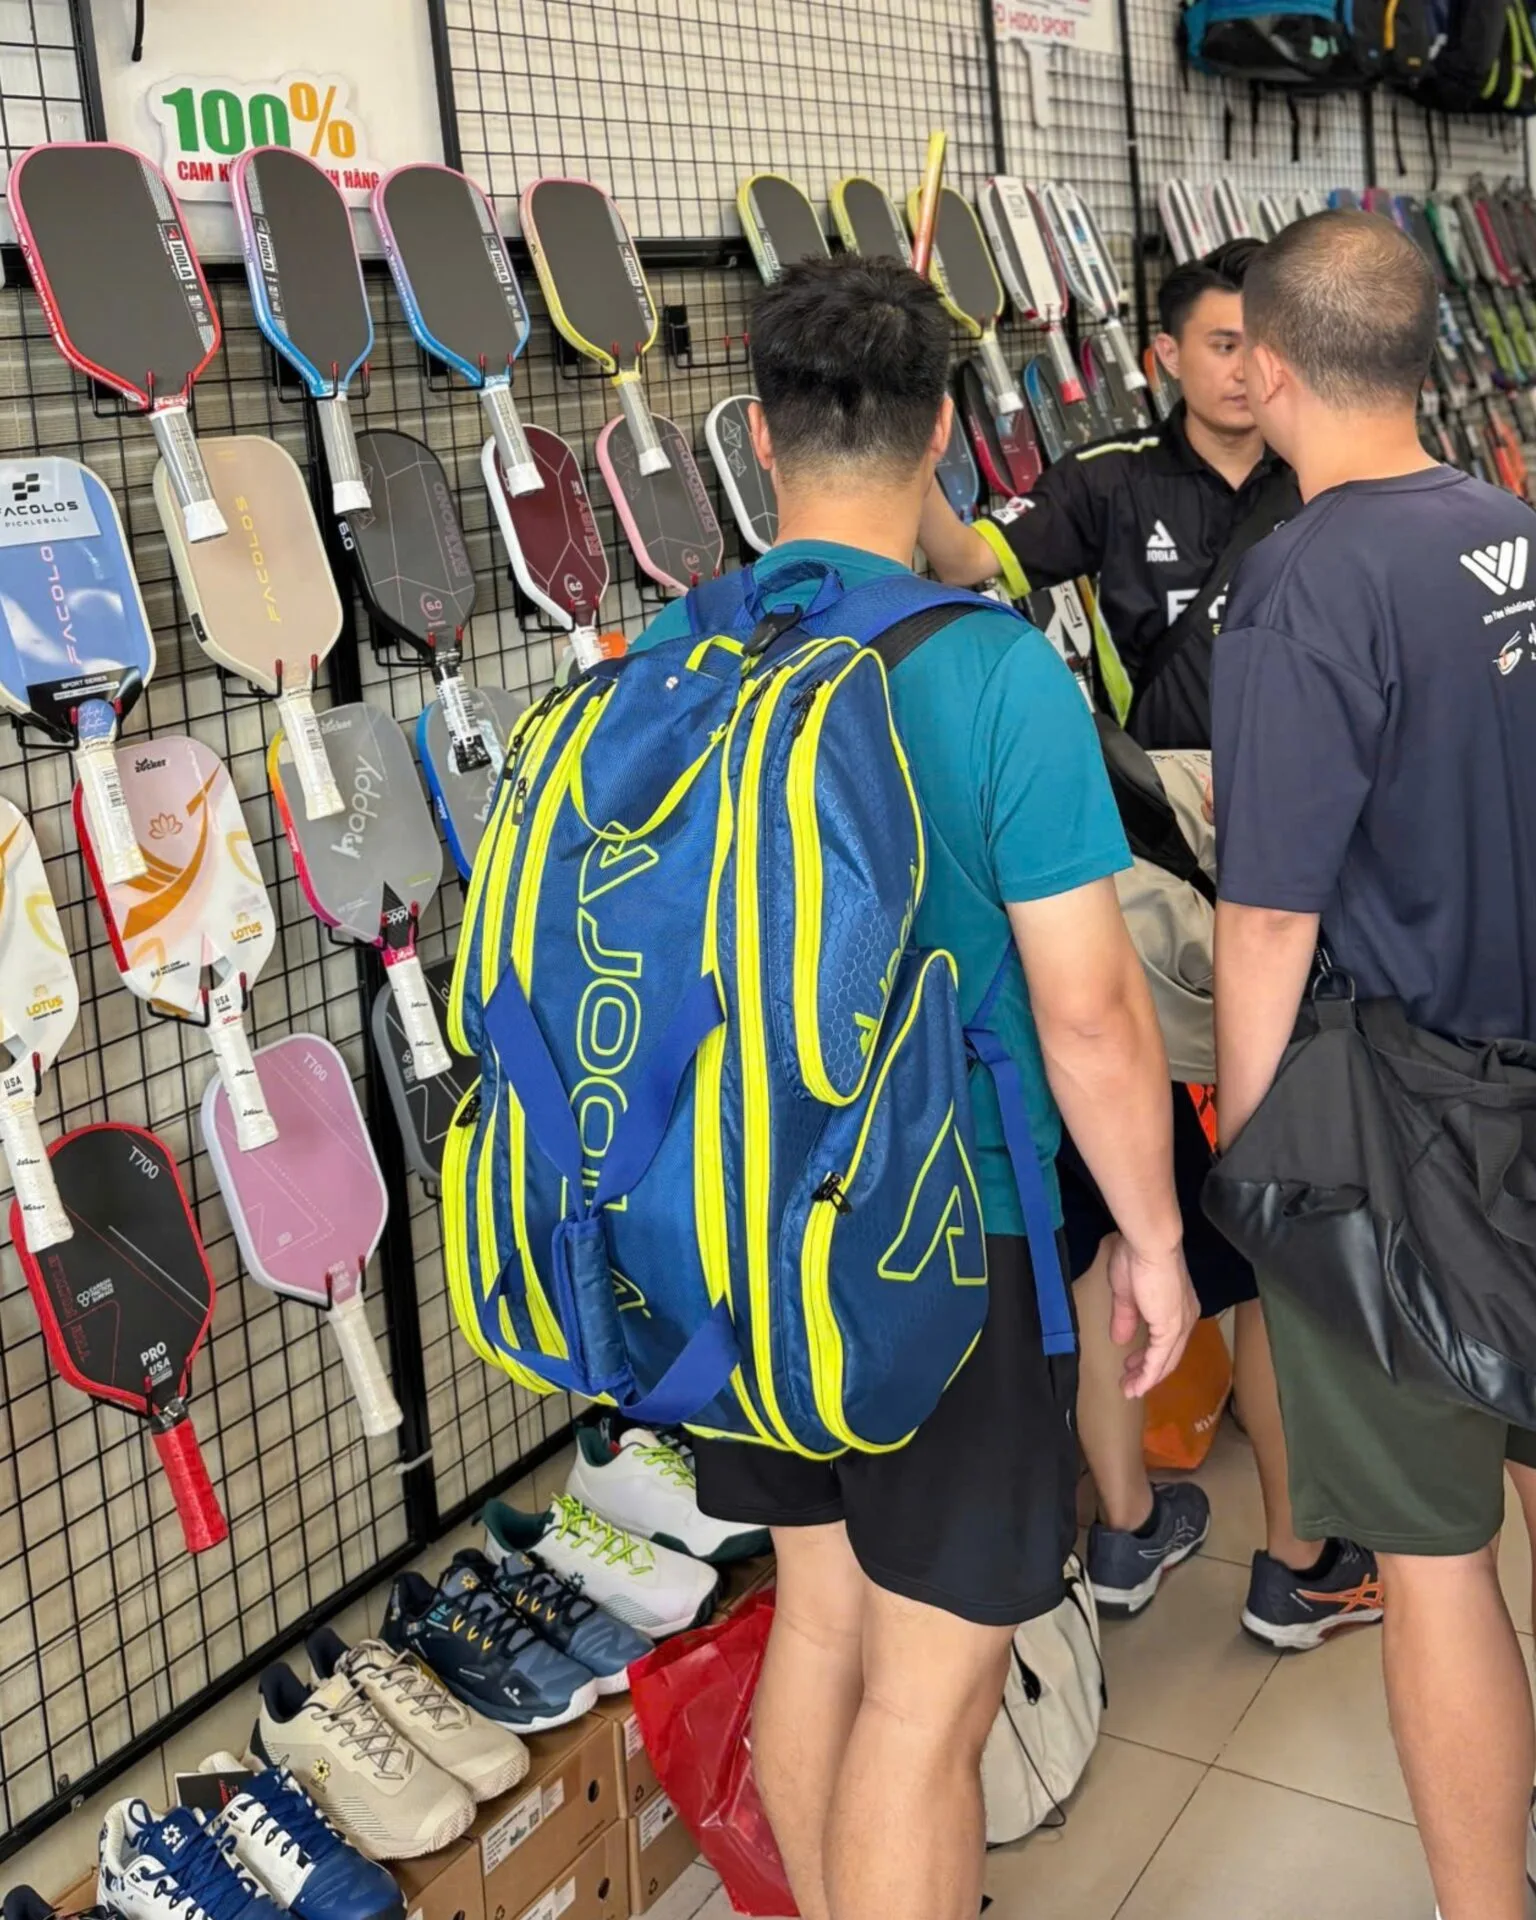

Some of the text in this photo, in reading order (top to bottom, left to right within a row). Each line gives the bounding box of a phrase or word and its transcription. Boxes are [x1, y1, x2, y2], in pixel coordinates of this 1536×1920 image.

[1041, 15, 1076, 40] SPORT
[162, 81, 356, 158] 100%
[177, 160, 213, 182] CAM
[171, 241, 193, 279] JOOLA
[258, 235, 275, 270] JOOLA
[0, 501, 79, 517] ACOLOS
[338, 521, 354, 550] 6.0
[235, 495, 281, 622] FACOLOS
[1146, 549, 1179, 562] JOOLA
[40, 545, 82, 665] FACOLO
[330, 754, 383, 859] happy
[231, 921, 262, 941] LOTUS
[27, 995, 64, 1017] LOTUS
[214, 995, 230, 1007] USA
[303, 1051, 328, 1082] T700
[4, 1075, 22, 1090] USA
[129, 1145, 159, 1180] T700
[140, 1341, 167, 1367] PRO
[149, 1356, 171, 1376] USA
